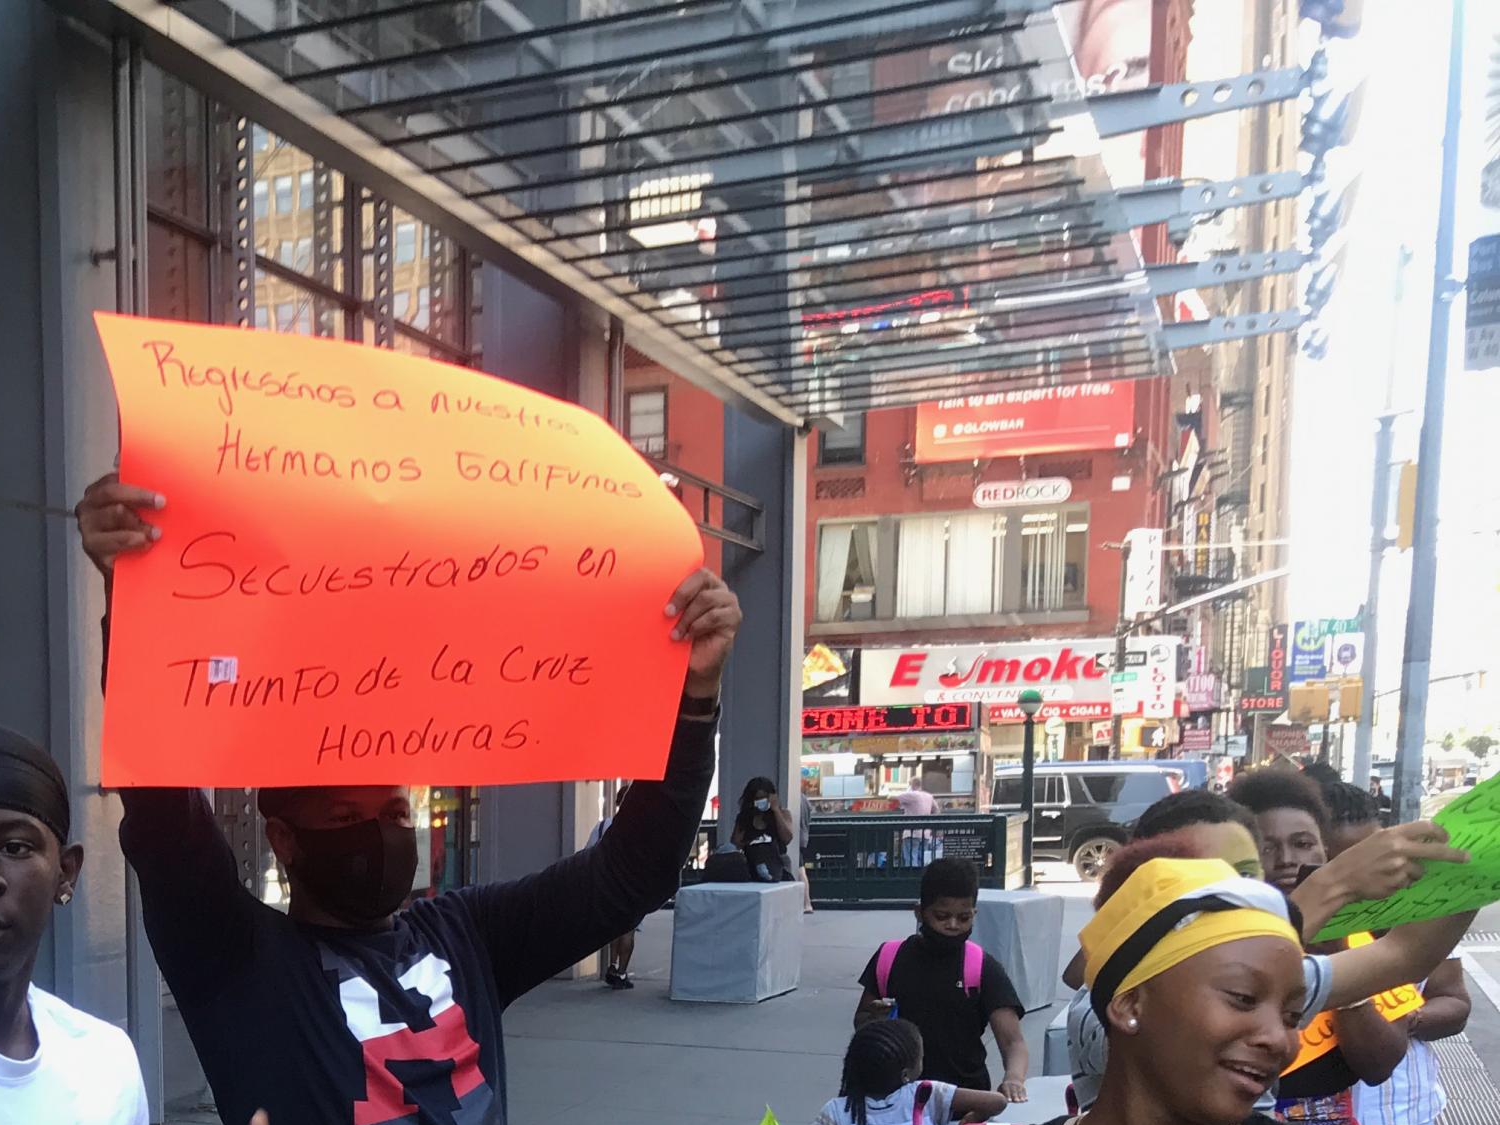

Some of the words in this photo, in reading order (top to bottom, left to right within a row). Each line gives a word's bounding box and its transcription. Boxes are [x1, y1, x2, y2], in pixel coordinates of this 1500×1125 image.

[217, 423, 422, 483] Hermanos
[982, 484, 1062, 501] REDROCK
[578, 547, 616, 578] en
[1332, 620, 1347, 633] 40
[889, 653, 928, 687] E
[1270, 627, 1285, 691] LIQUOR
[355, 656, 400, 695] de
[1069, 705, 1102, 717] CIGAR
[1241, 697, 1284, 709] STORE
[912, 706, 958, 728] TO
